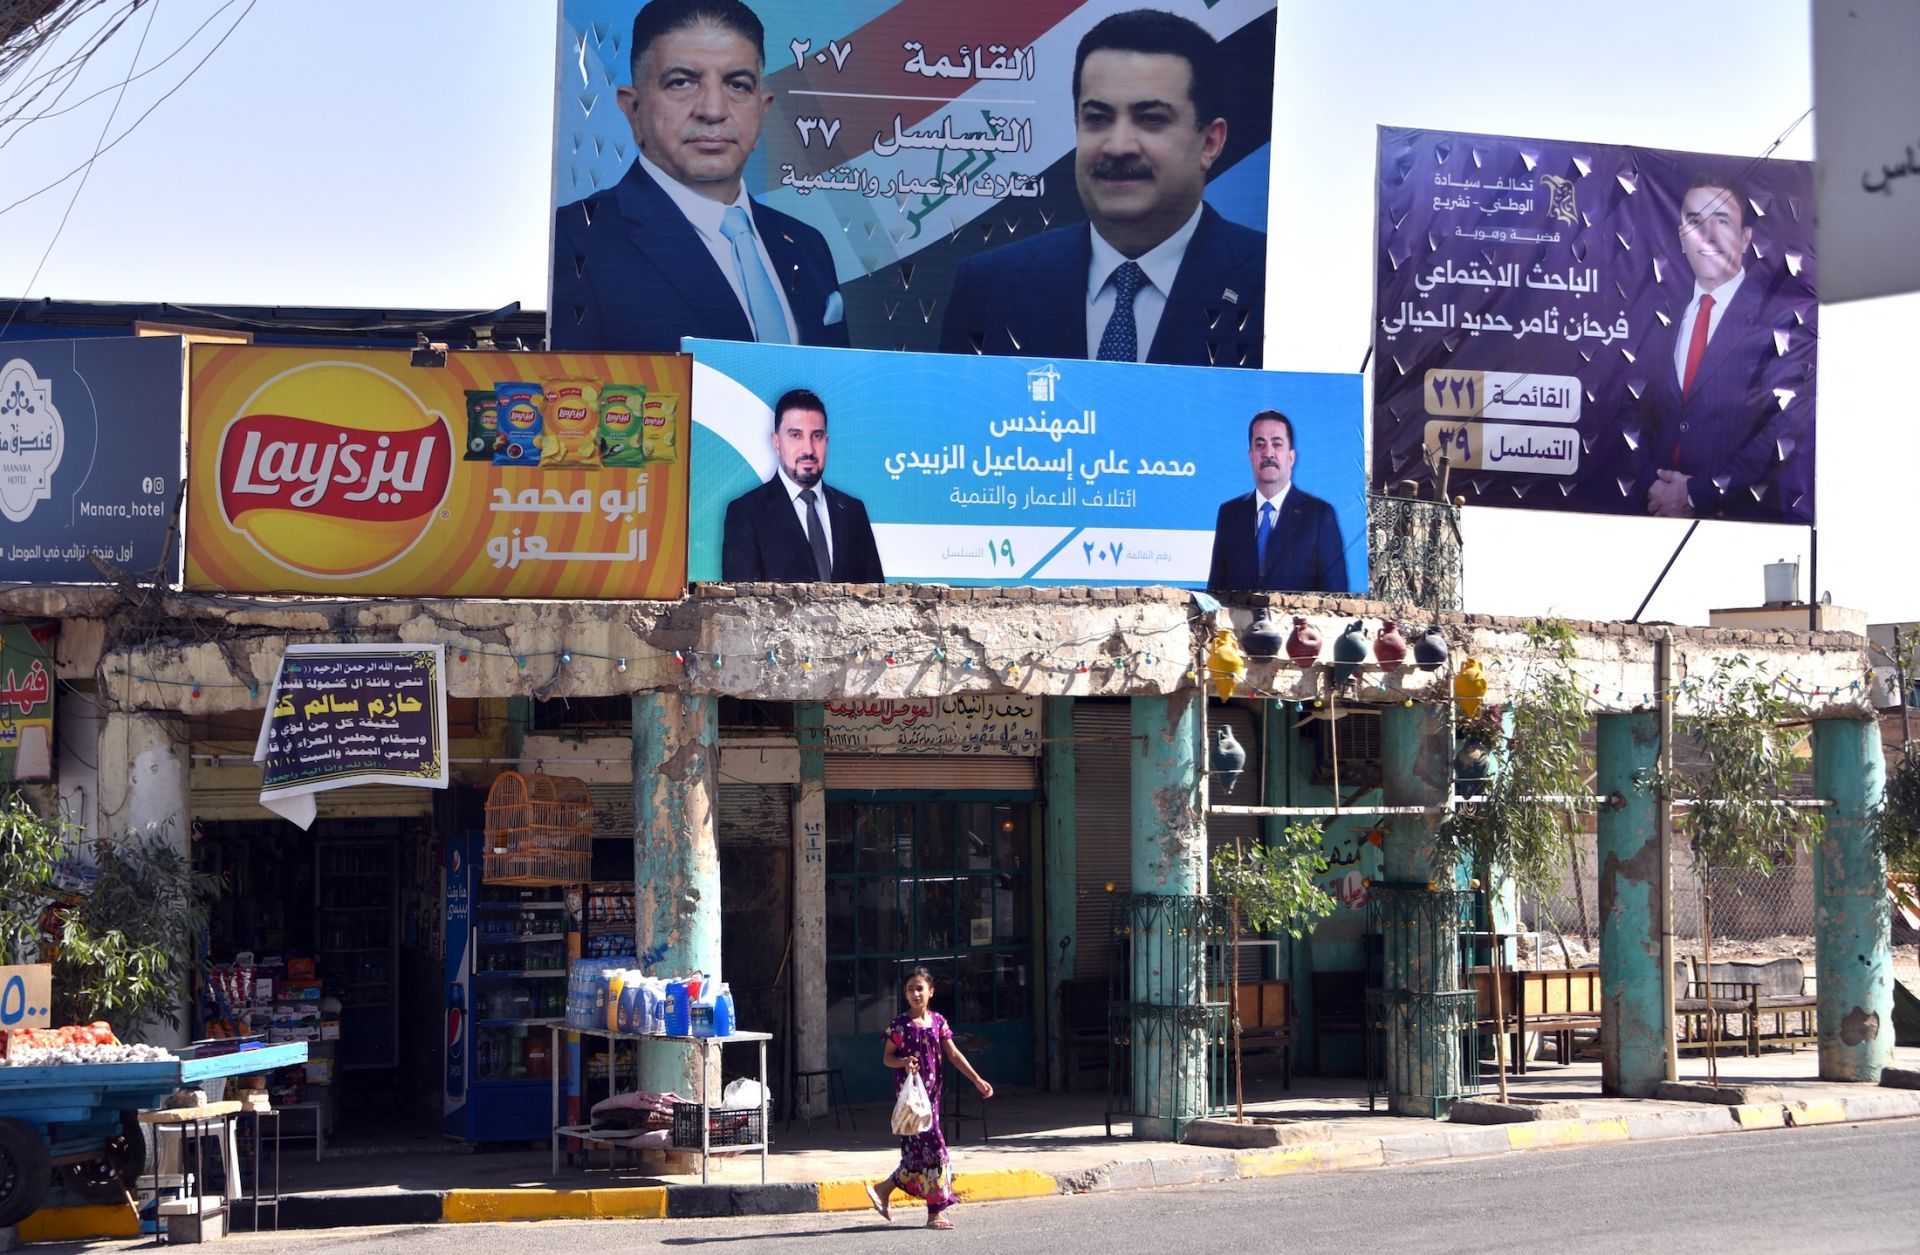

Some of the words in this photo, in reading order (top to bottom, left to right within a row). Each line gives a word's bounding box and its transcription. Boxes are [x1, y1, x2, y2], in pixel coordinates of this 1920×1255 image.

[790, 38, 852, 73] ٢٠٧
[904, 41, 1035, 81] القائمة
[797, 118, 842, 150] ٣٧
[873, 112, 1032, 157] التسلسل
[781, 164, 882, 197] والتنمية
[880, 170, 969, 199] الاعمار
[973, 173, 1045, 199] ائتلاف
[1434, 173, 1480, 190] سيادة
[1483, 179, 1534, 192] تحالف
[1432, 194, 1470, 211] تشريع
[1455, 226, 1507, 242] وهوية
[1510, 229, 1560, 243] قضية
[1414, 260, 1519, 298] الاجتماعي
[1526, 267, 1598, 298] الباحث
[1382, 301, 1456, 341] الحيالي
[1460, 306, 1510, 334] حديد
[1511, 307, 1560, 341] ثامر
[1563, 309, 1630, 346] فرحان
[1432, 376, 1476, 410] ٢٢١
[1492, 383, 1571, 409] القائمة
[989, 409, 1097, 441] المهندس
[1489, 436, 1573, 464] التسلسل
[3, 464, 32, 473] MANARA
[233, 431, 364, 508] Lay's
[364, 432, 437, 504] ليز
[884, 445, 966, 479] الزبيدي
[972, 448, 1074, 481] إسماعيل
[1079, 450, 1131, 486] علي
[1136, 457, 1197, 478] محمد
[7, 476, 27, 485] HOTEL
[489, 485, 592, 514] محمد
[600, 472, 648, 522] أبو
[949, 486, 1017, 508] والتنمية
[1021, 486, 1077, 511] الاعمار
[1082, 487, 1137, 511] ائتلاف
[80, 502, 164, 518] Manara_hotel
[8, 545, 41, 562] الموصل
[43, 546, 60, 562] في
[116, 541, 133, 562] أول
[942, 547, 983, 559] التسلسل
[988, 538, 1016, 568] ١٩
[1083, 541, 1124, 567] ٢٠٧
[313, 663, 342, 673] الرحيم
[343, 663, 377, 674] الرحمن
[378, 661, 393, 672] الله
[394, 664, 413, 672] بسم
[306, 677, 347, 690] كشمولة
[366, 677, 391, 687] عائلة
[394, 677, 423, 689] تنعى
[304, 693, 359, 721] سالم
[367, 691, 423, 718] حازم
[995, 695, 1033, 717] تحف
[308, 721, 329, 732] من
[335, 717, 355, 729] كل
[359, 718, 400, 729] شقيقة
[297, 734, 333, 749] العزاء
[338, 732, 376, 746] مجلس
[381, 736, 427, 746] وسيقام
[300, 748, 342, 763] والسبت
[345, 747, 381, 757] الجمعة
[384, 749, 420, 760] ليومي
